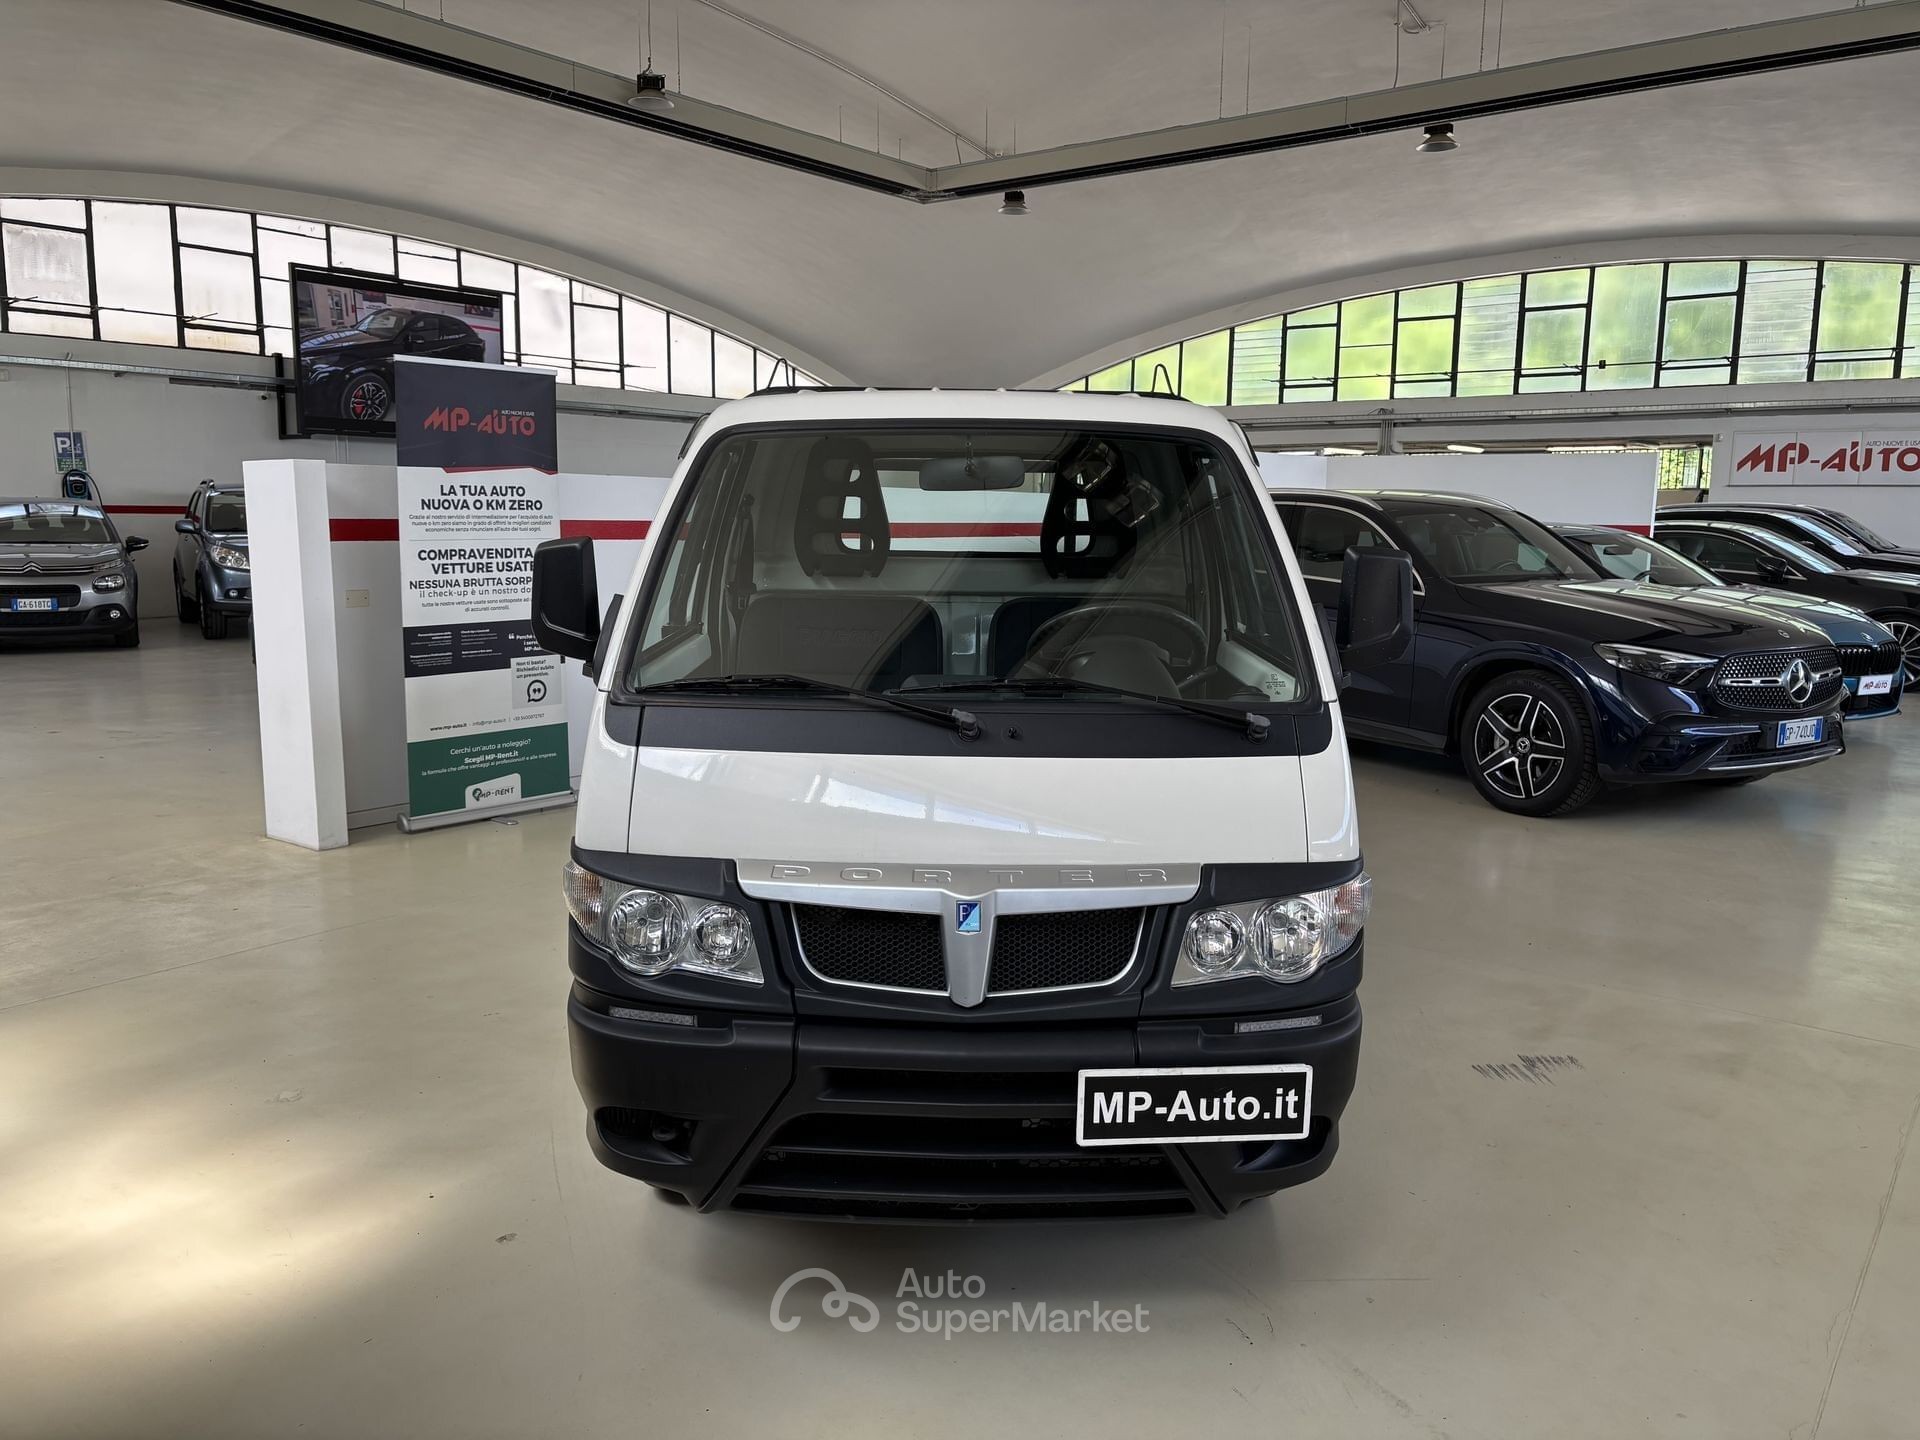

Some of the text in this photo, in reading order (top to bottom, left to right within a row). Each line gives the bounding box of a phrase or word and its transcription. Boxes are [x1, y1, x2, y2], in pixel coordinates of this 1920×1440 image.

[424, 407, 536, 436] MP-AUTO
[56, 437, 70, 454] P
[1736, 441, 1920, 472] MP-AUTO
[440, 485, 526, 497] LA TUA AUTO
[421, 499, 542, 511] NUOVA O KM ZERO
[418, 548, 533, 561] COMPRAVENDITA
[432, 562, 493, 574] VETTURE
[409, 576, 533, 590] NESSUNA BRUTTA SORP
[428, 589, 468, 598] check-up
[450, 746, 471, 755] Cerchi
[472, 744, 496, 752] un'auto
[502, 739, 531, 748] noleggio?
[464, 755, 484, 764] Scegli
[770, 864, 1168, 883] PORTER
[1092, 1088, 1299, 1124] MP-Auto.it
